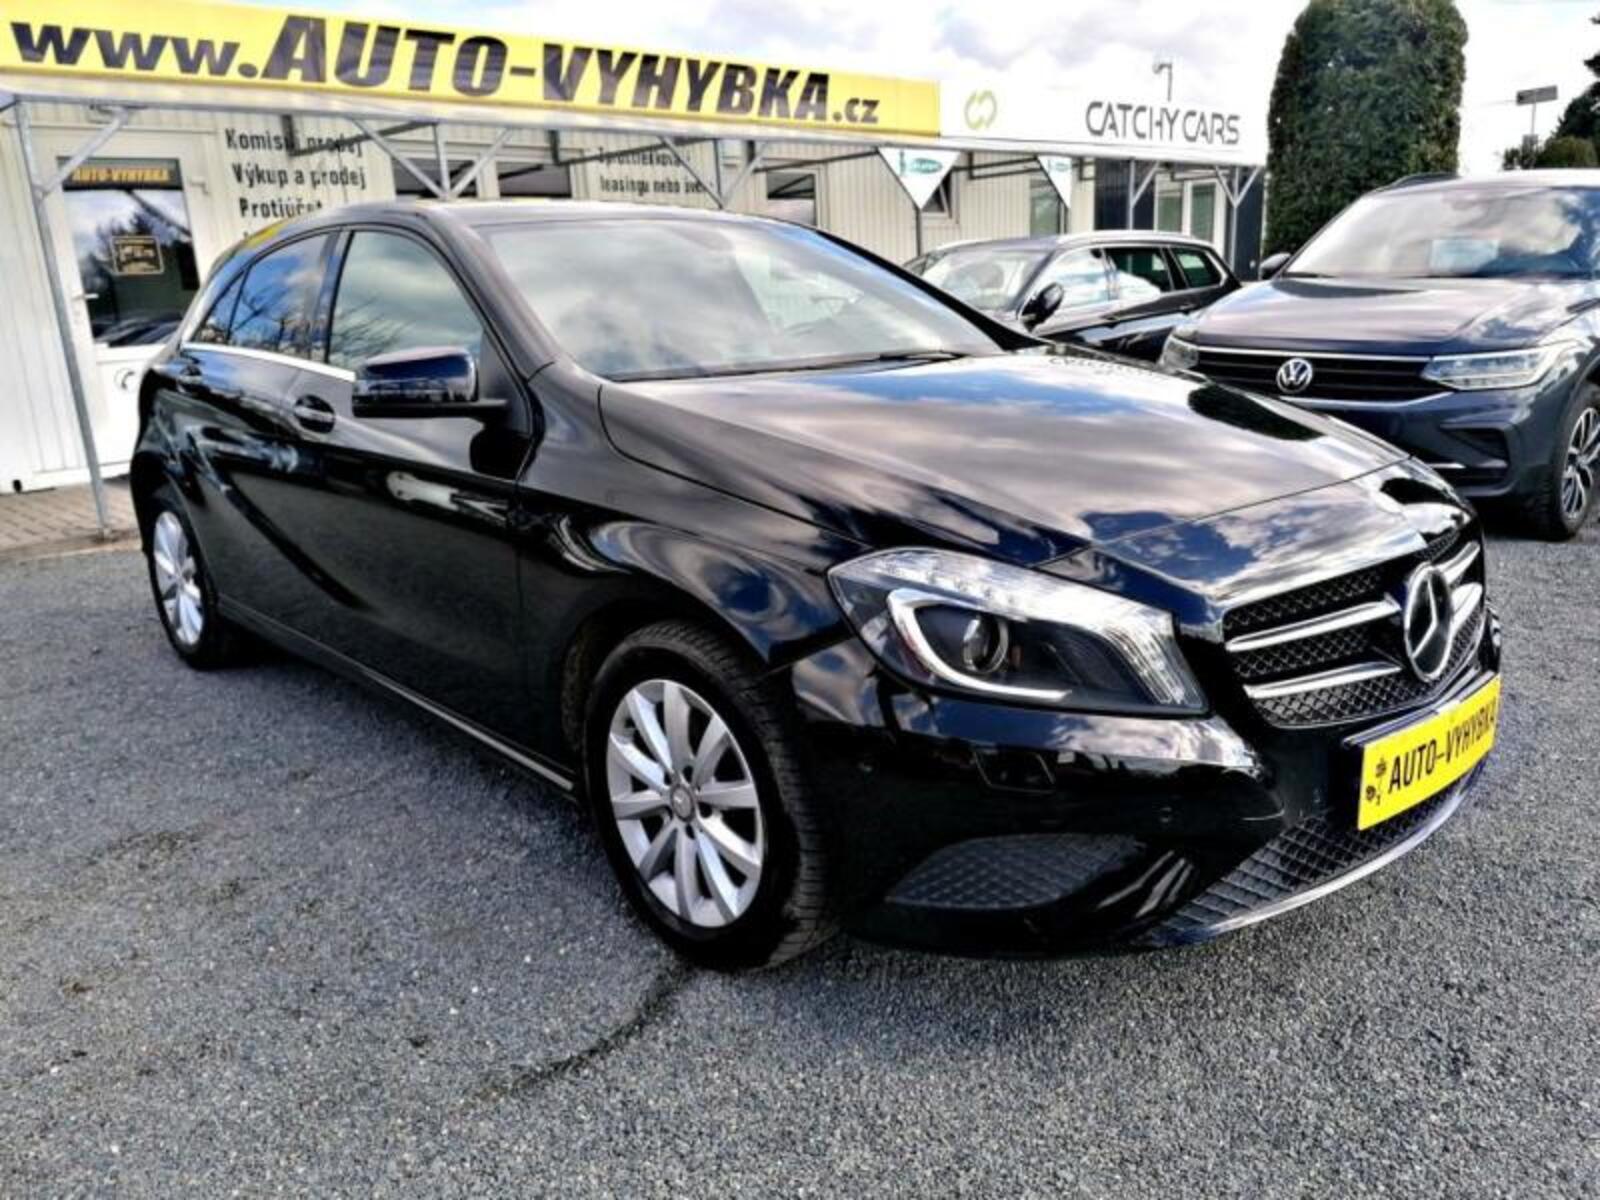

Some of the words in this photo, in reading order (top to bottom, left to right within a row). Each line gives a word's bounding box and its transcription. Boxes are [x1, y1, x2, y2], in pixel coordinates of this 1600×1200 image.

[10, 14, 880, 125] www.AUTO-VYHYBKA.cz
[1085, 100, 1180, 141] CATCHY
[1182, 109, 1241, 144] CARS
[232, 163, 288, 188] Výkup
[295, 169, 304, 184] a
[310, 166, 366, 190] prodej
